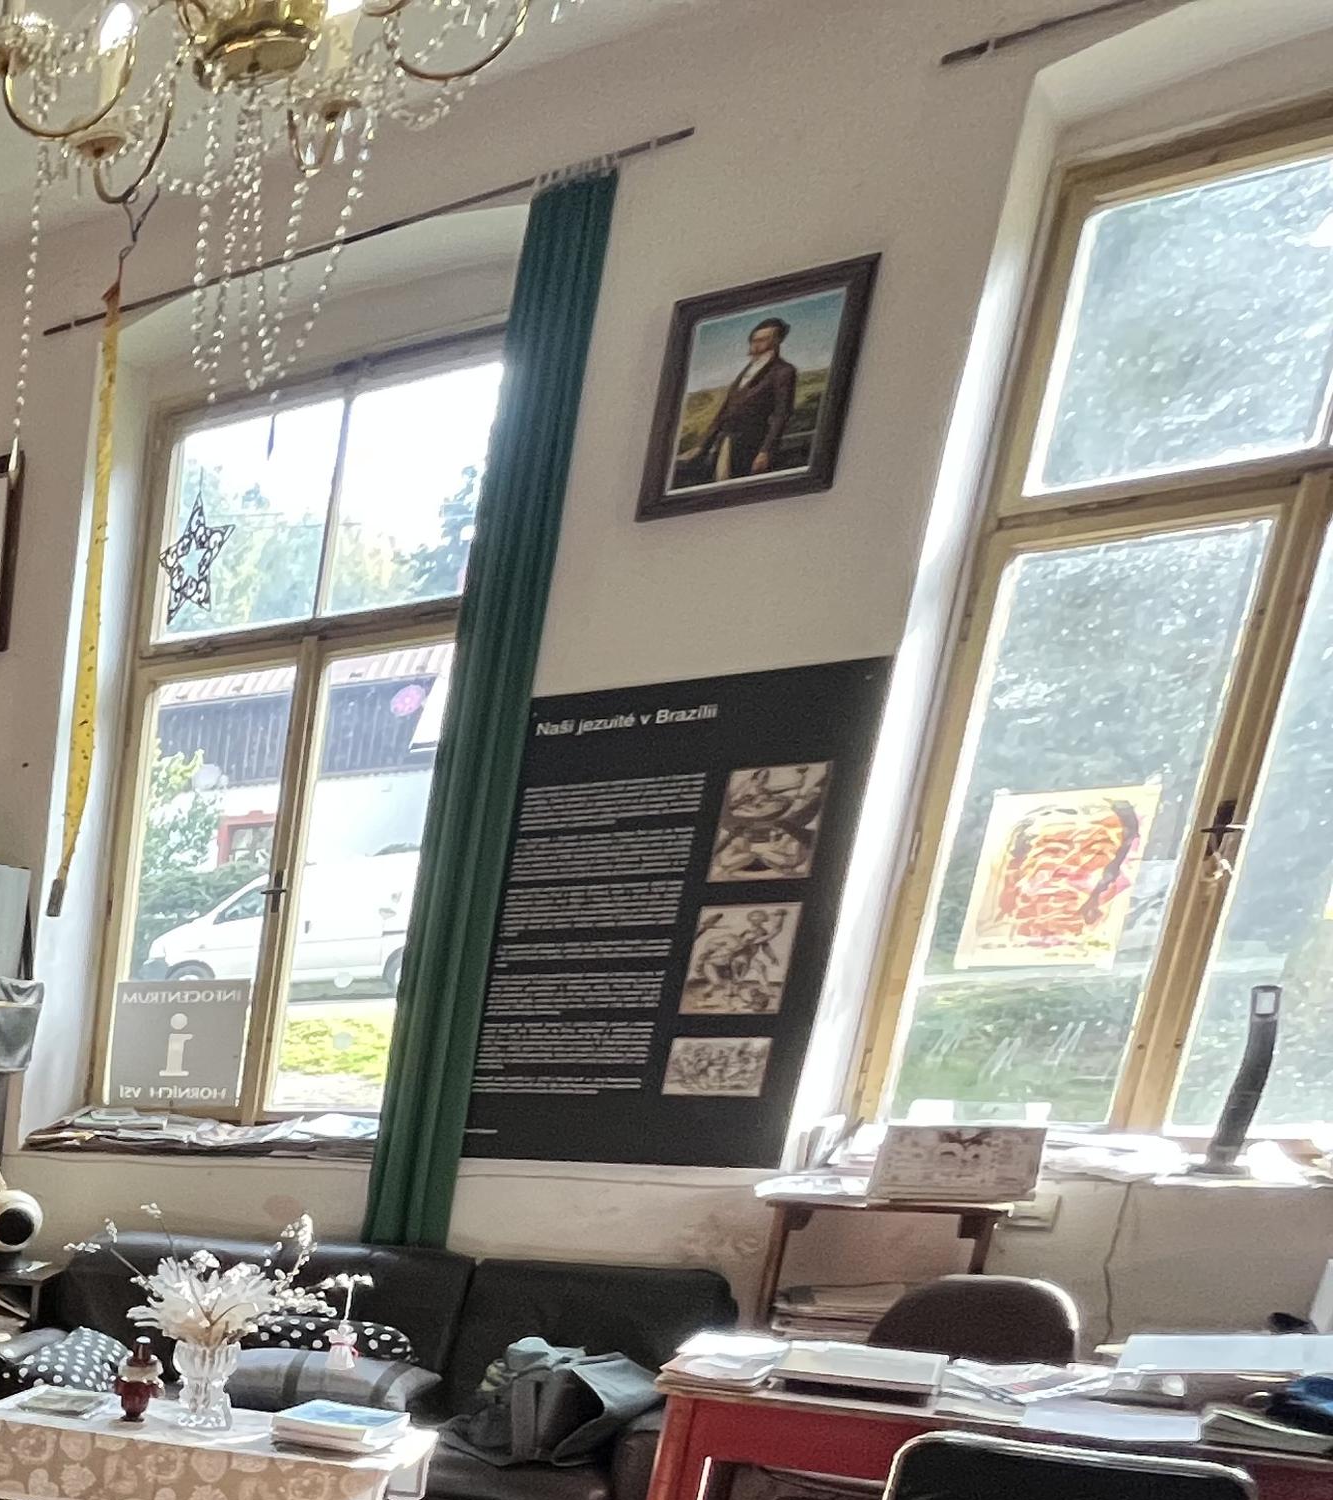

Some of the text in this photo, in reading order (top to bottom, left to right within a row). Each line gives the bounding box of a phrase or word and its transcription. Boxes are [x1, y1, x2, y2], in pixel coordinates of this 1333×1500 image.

[535, 704, 718, 737] Naši jezuité v Brazílii
